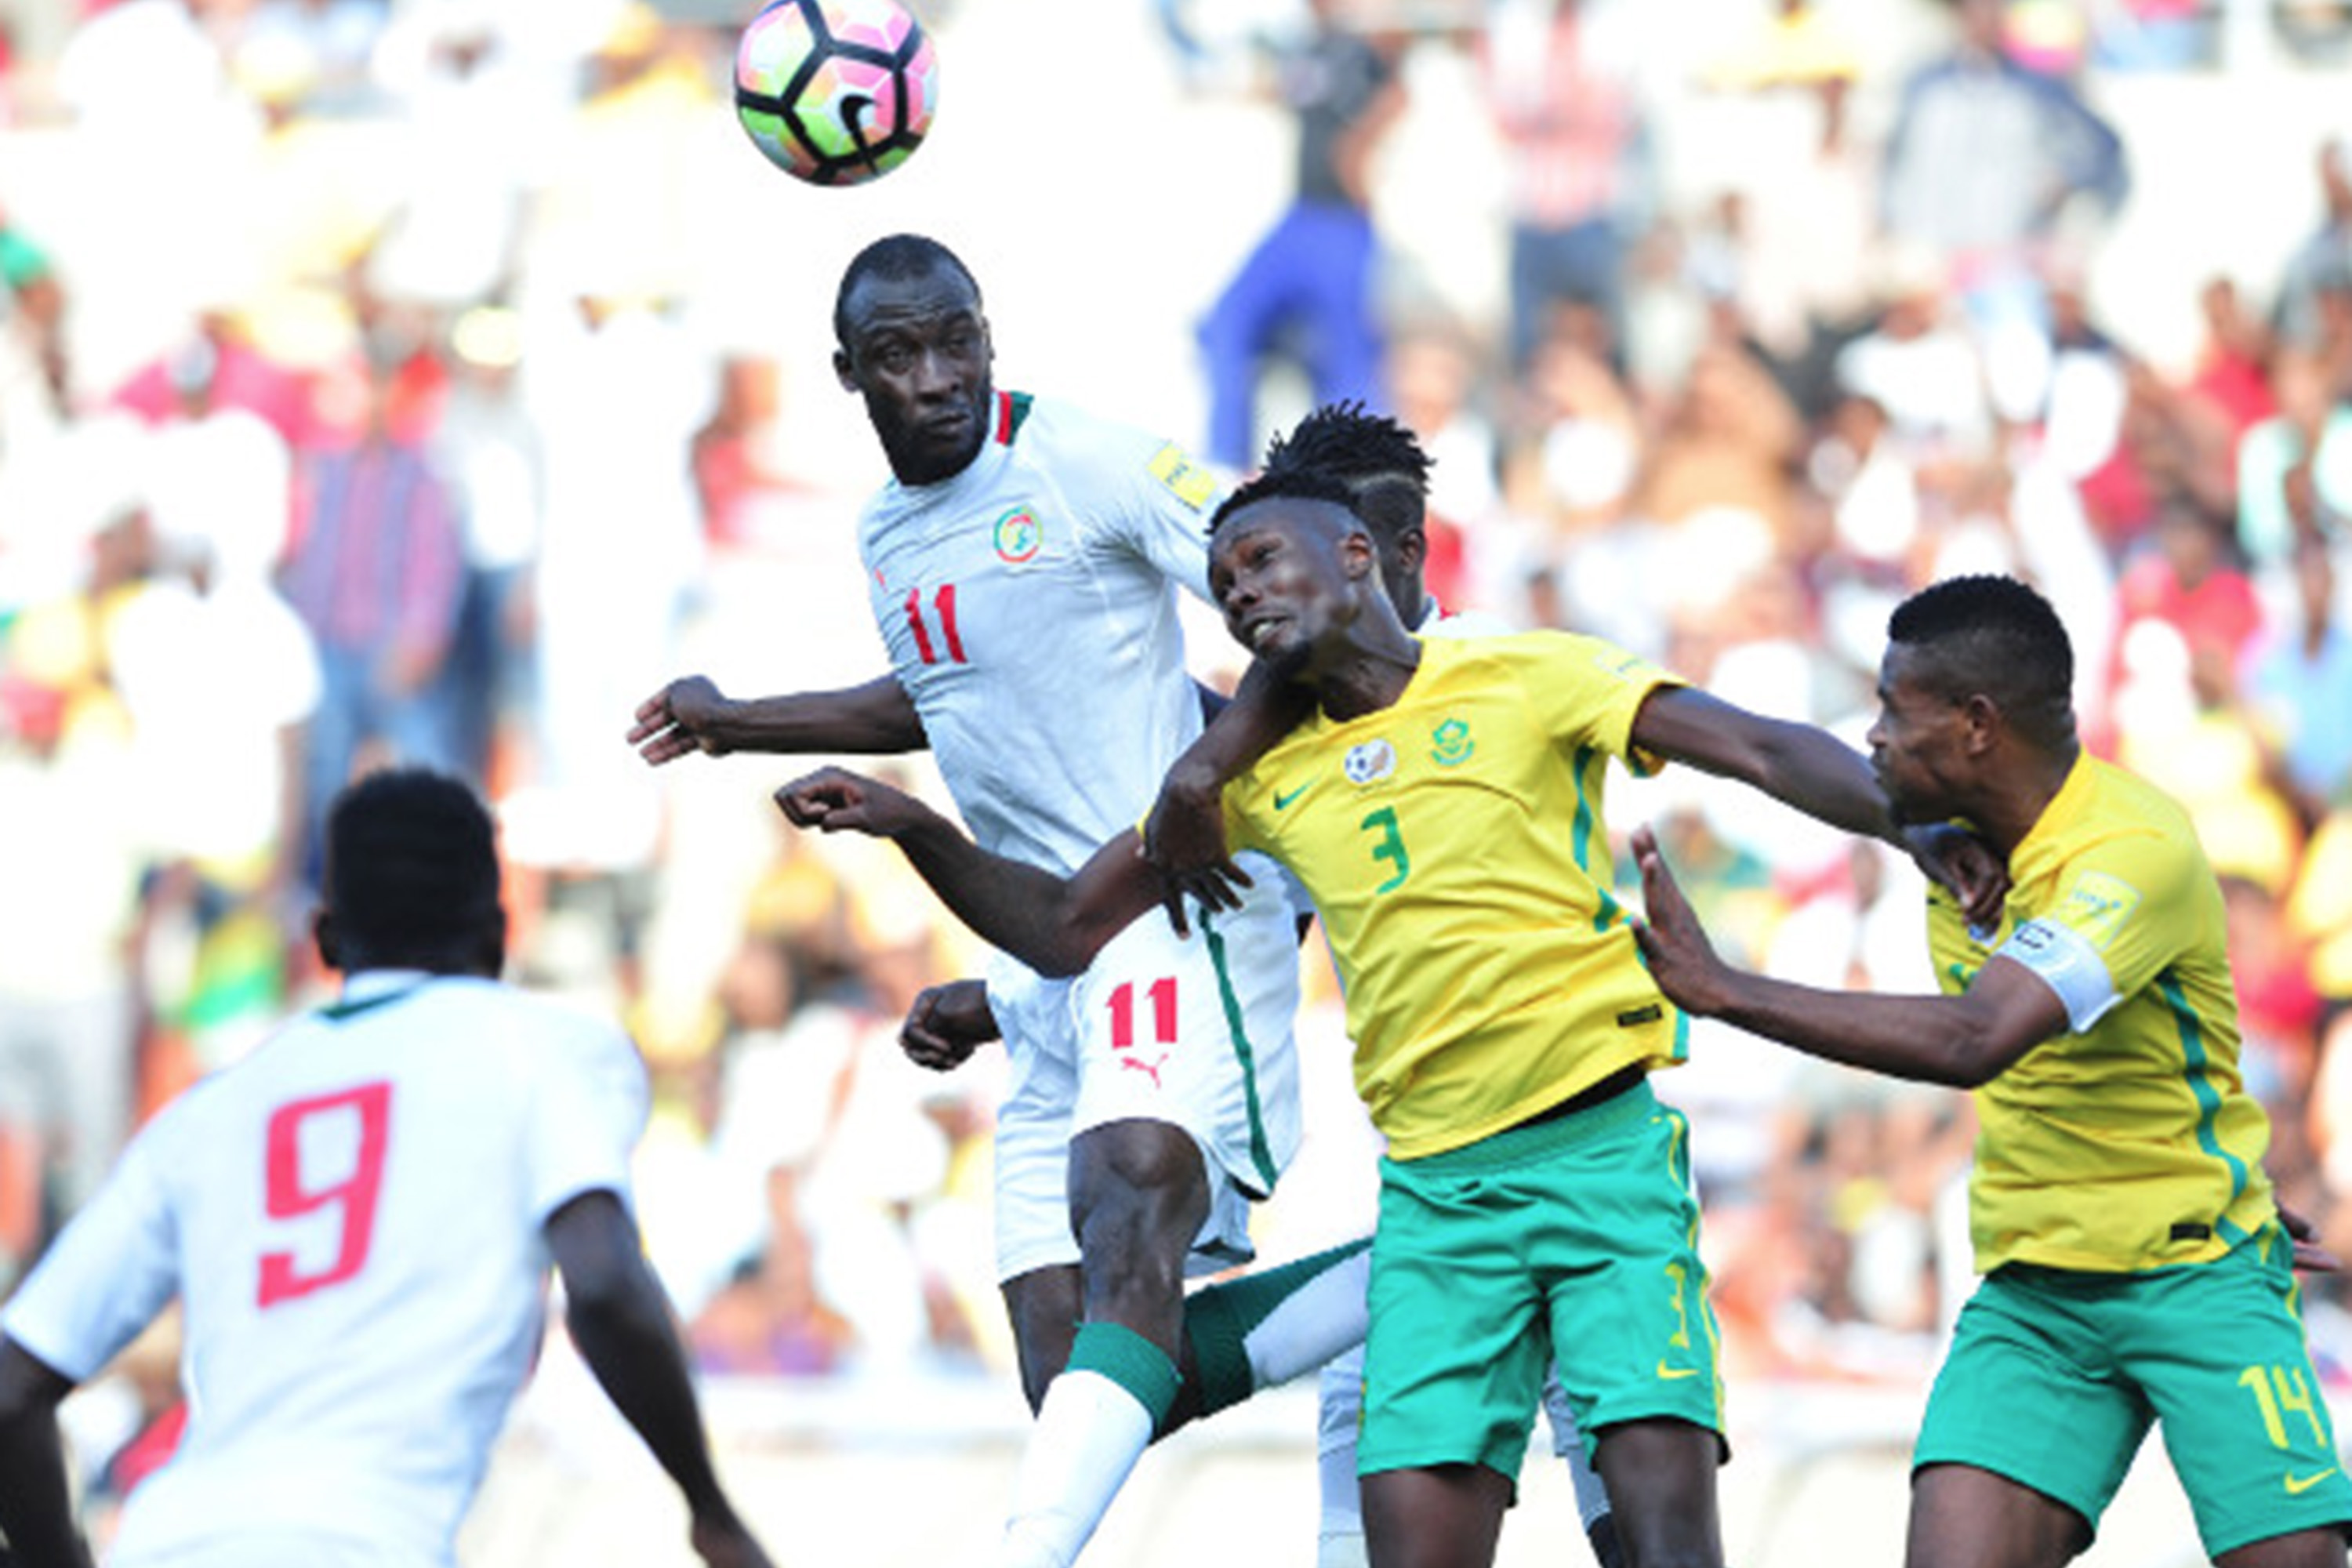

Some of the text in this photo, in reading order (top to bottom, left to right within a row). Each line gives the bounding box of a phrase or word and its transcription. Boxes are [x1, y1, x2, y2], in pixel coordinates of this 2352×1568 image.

[904, 583, 968, 665] 11
[1361, 805, 1410, 895] 3
[1104, 977, 1178, 1050] 11
[256, 1080, 393, 1308] 9
[2238, 1365, 2327, 1449] 14
